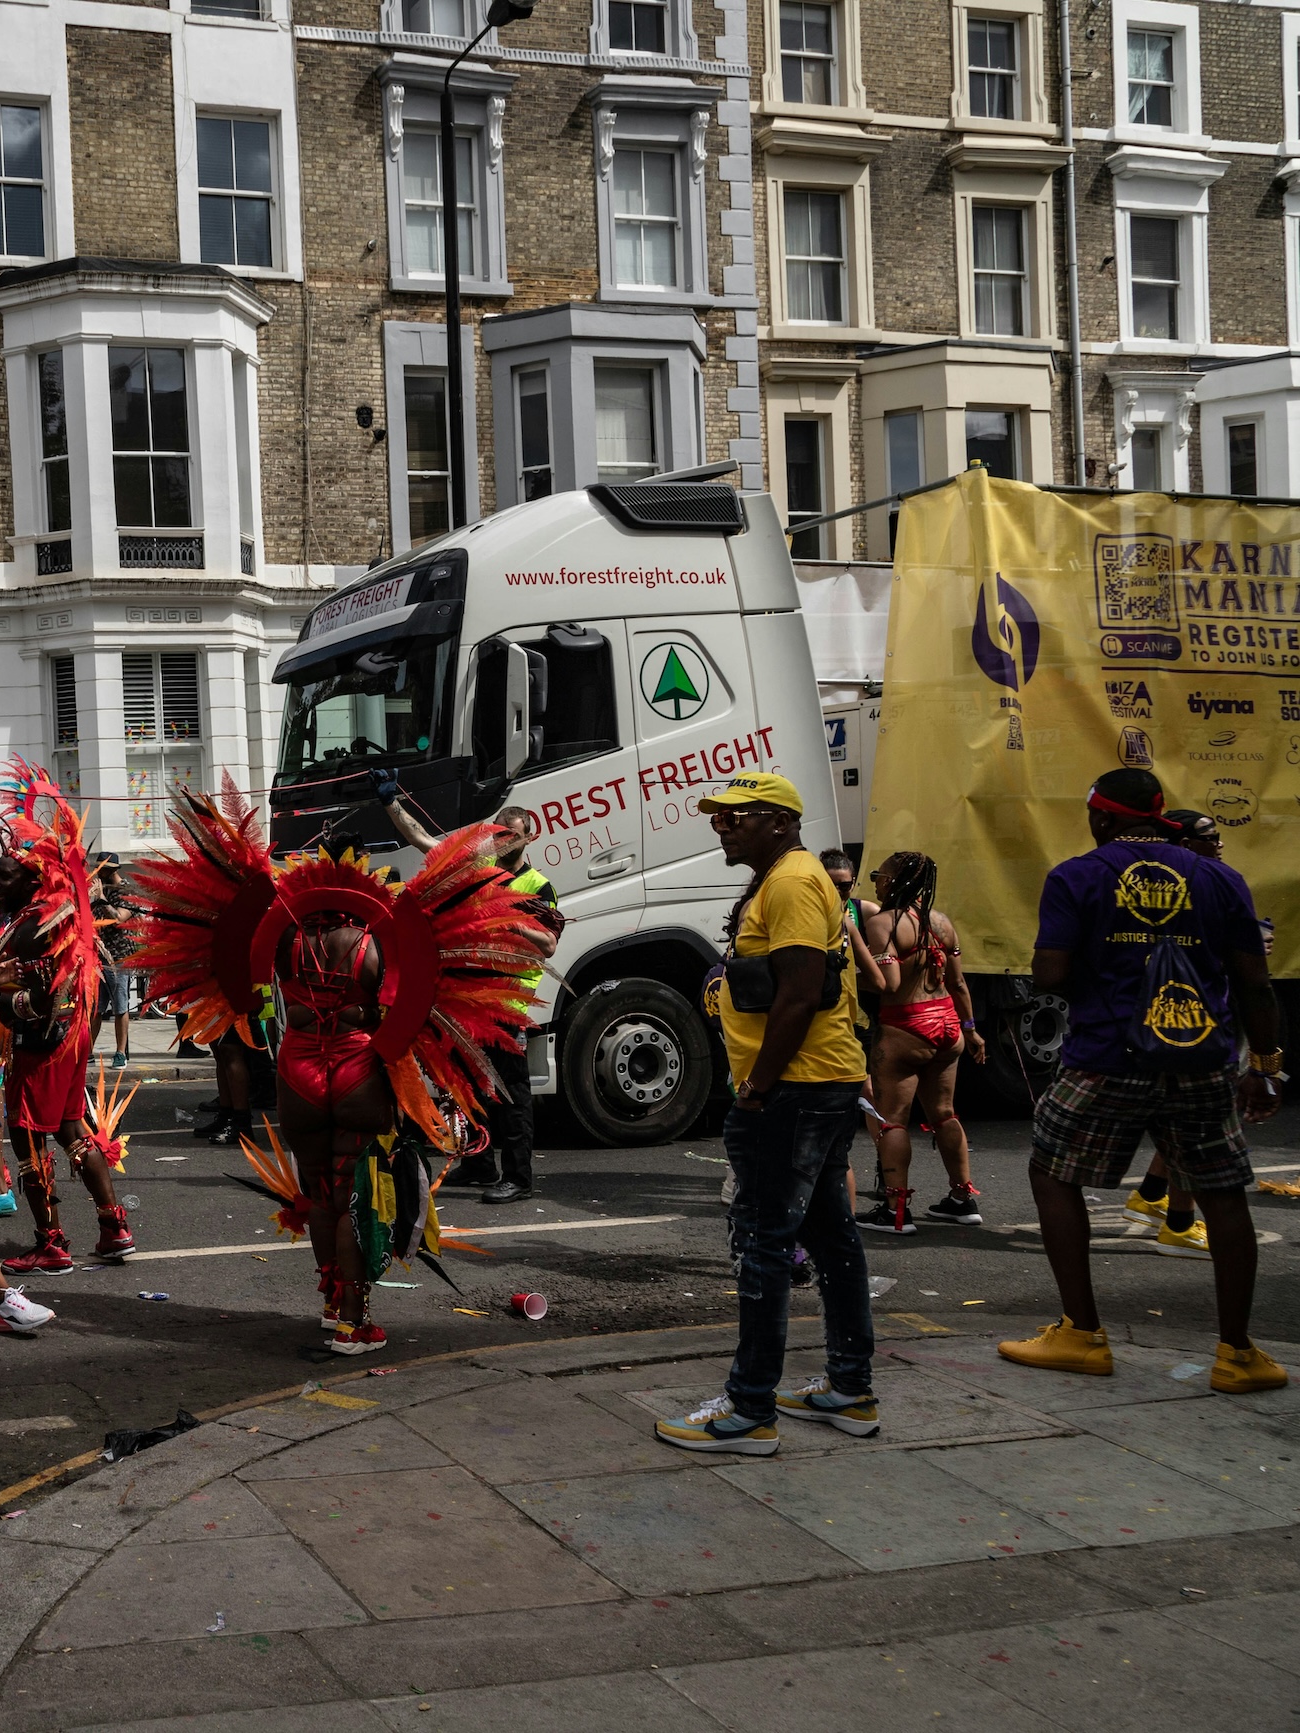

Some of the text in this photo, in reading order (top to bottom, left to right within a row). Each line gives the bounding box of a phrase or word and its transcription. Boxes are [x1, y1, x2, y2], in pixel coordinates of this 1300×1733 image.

[1180, 539, 1300, 577] KARN
[505, 567, 727, 588] www.forestfreight.co.uk
[314, 578, 404, 628] FOREST FREIGHT
[345, 599, 398, 626] LOGISTICS
[1126, 641, 1173, 655] SCAN ME
[1191, 650, 1210, 662] TO
[1217, 651, 1256, 664] JOIN
[1261, 653, 1275, 666] US
[1187, 691, 1254, 719] tiyana
[1278, 690, 1300, 705] TE
[1111, 706, 1153, 718] FESTIVAL
[638, 727, 773, 802] FREIGHT
[1187, 752, 1264, 761] TOUCH OF CLASS
[1213, 778, 1242, 787] TWIN
[526, 777, 626, 842] OREST
[1216, 814, 1252, 827] CLEAN
[1111, 932, 1148, 943] JUSTICE
[1143, 1008, 1218, 1029] MANIA
